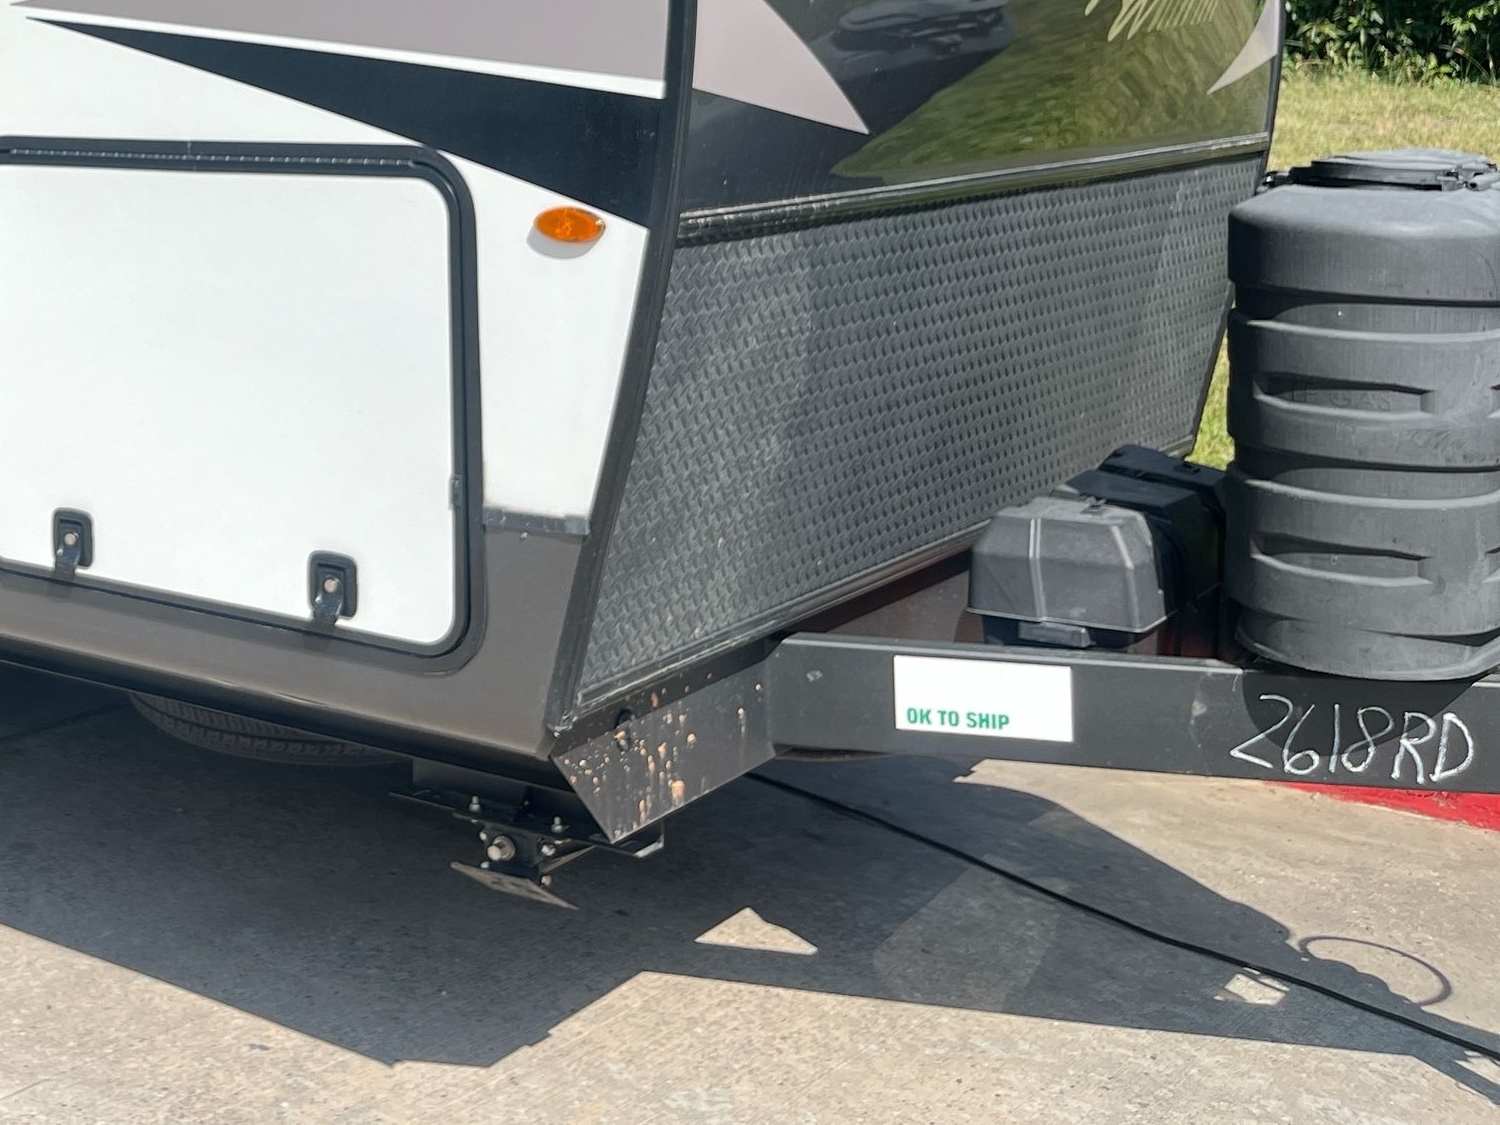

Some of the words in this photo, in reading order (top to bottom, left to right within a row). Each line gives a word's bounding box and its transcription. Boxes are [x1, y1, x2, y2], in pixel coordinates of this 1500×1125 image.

[906, 707, 932, 725] OK
[937, 709, 960, 727] TO
[966, 712, 1010, 730] SHIP
[1229, 694, 1474, 784] 2618RD
